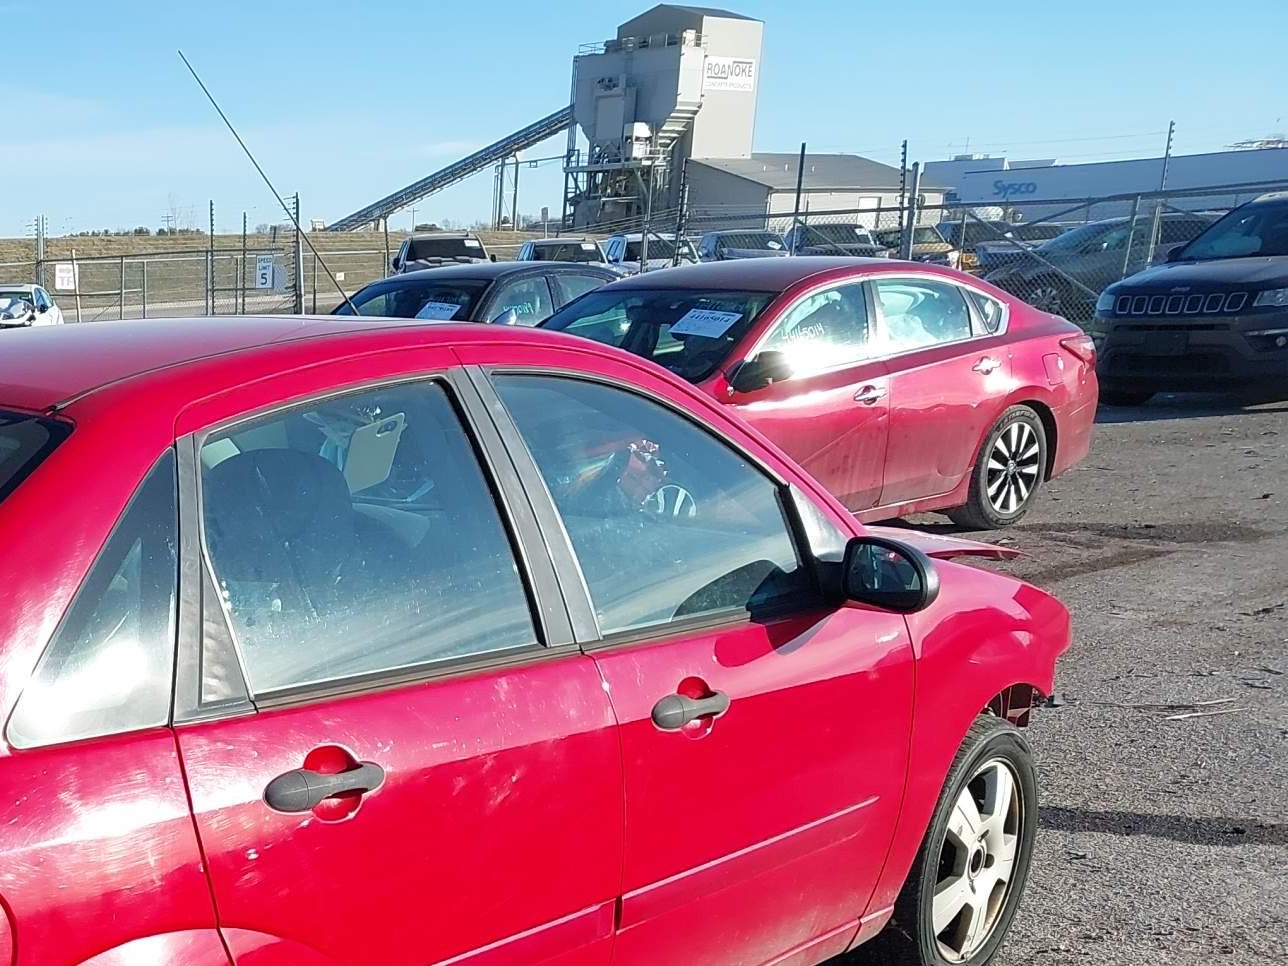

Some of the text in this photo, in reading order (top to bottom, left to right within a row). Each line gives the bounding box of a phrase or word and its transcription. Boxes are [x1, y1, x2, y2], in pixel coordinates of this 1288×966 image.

[706, 61, 753, 78] ROANOKE
[993, 180, 1037, 199] Sysco
[260, 272, 268, 286] 5
